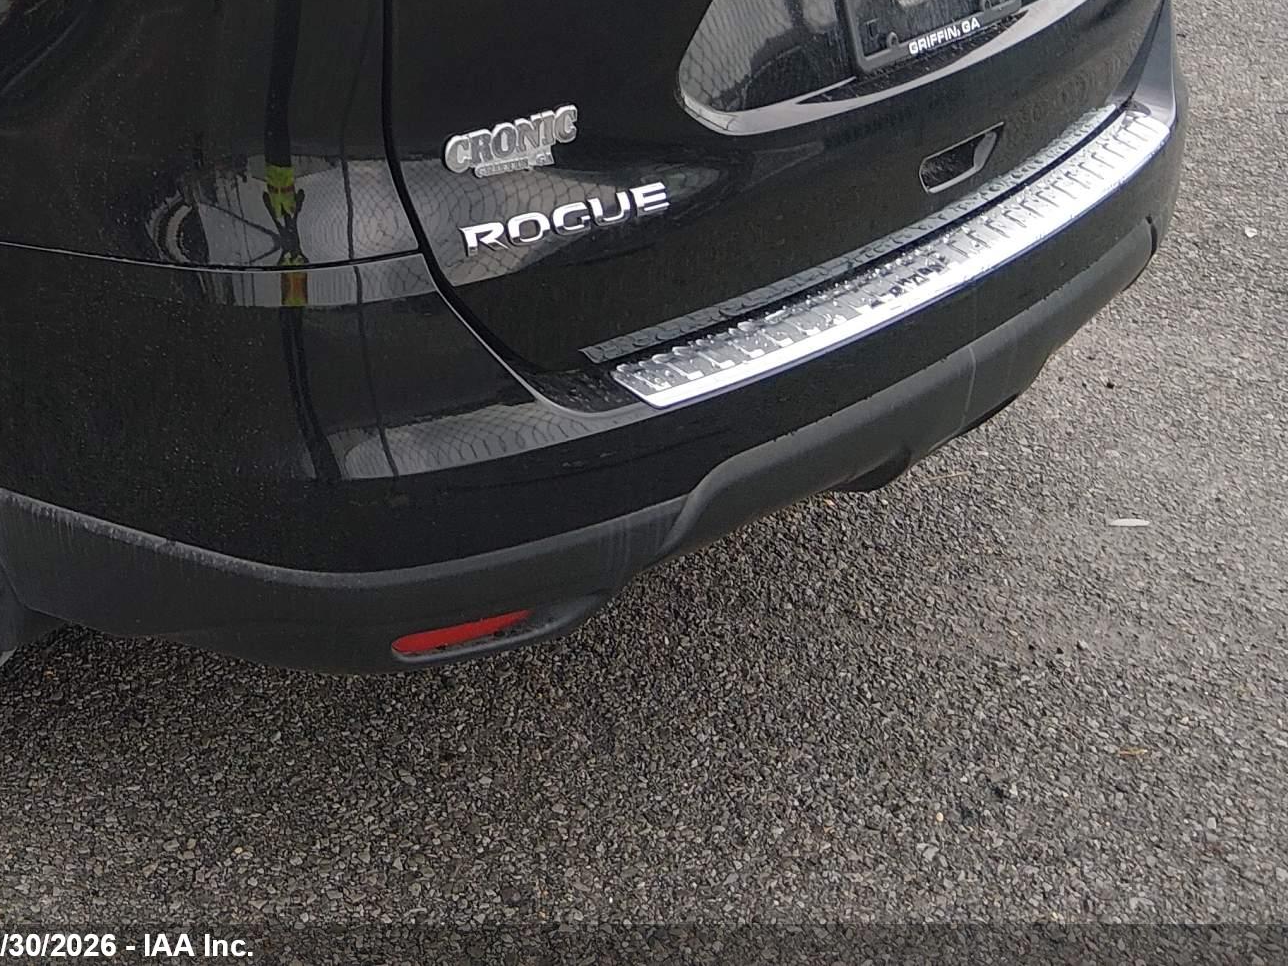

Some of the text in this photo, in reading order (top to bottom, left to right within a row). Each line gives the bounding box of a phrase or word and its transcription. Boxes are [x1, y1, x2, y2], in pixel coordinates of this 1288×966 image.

[961, 17, 981, 34] GA
[445, 104, 578, 173] CRONIC
[459, 181, 670, 257] ROGUE
